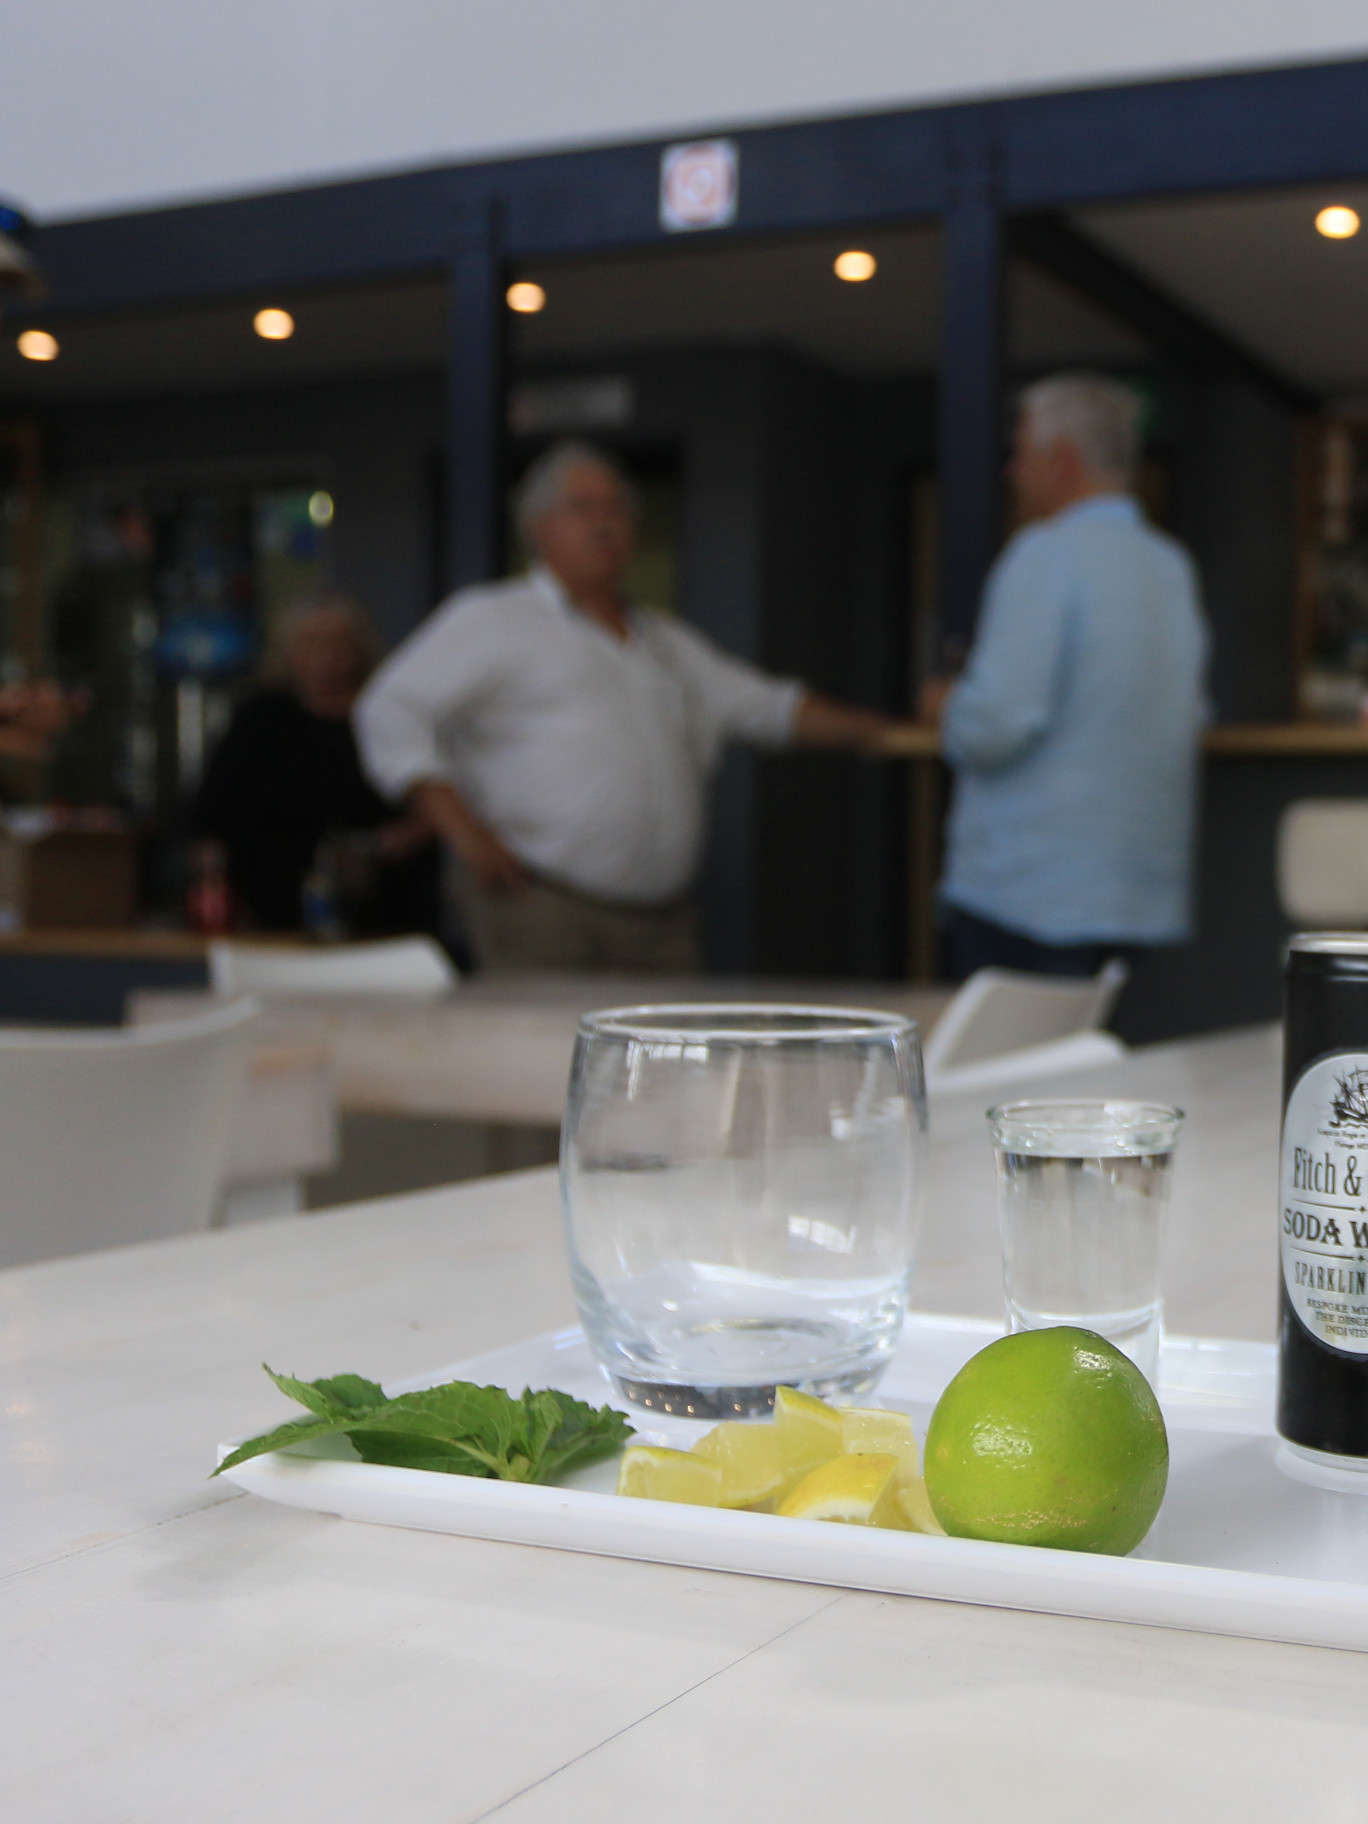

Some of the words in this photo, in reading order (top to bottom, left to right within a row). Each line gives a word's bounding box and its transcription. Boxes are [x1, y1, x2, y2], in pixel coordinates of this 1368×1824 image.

[1293, 1147, 1337, 1195] Fitch
[1344, 1156, 1362, 1197] &
[1283, 1207, 1344, 1248] SODA
[1306, 1298, 1349, 1314] BESPOKE
